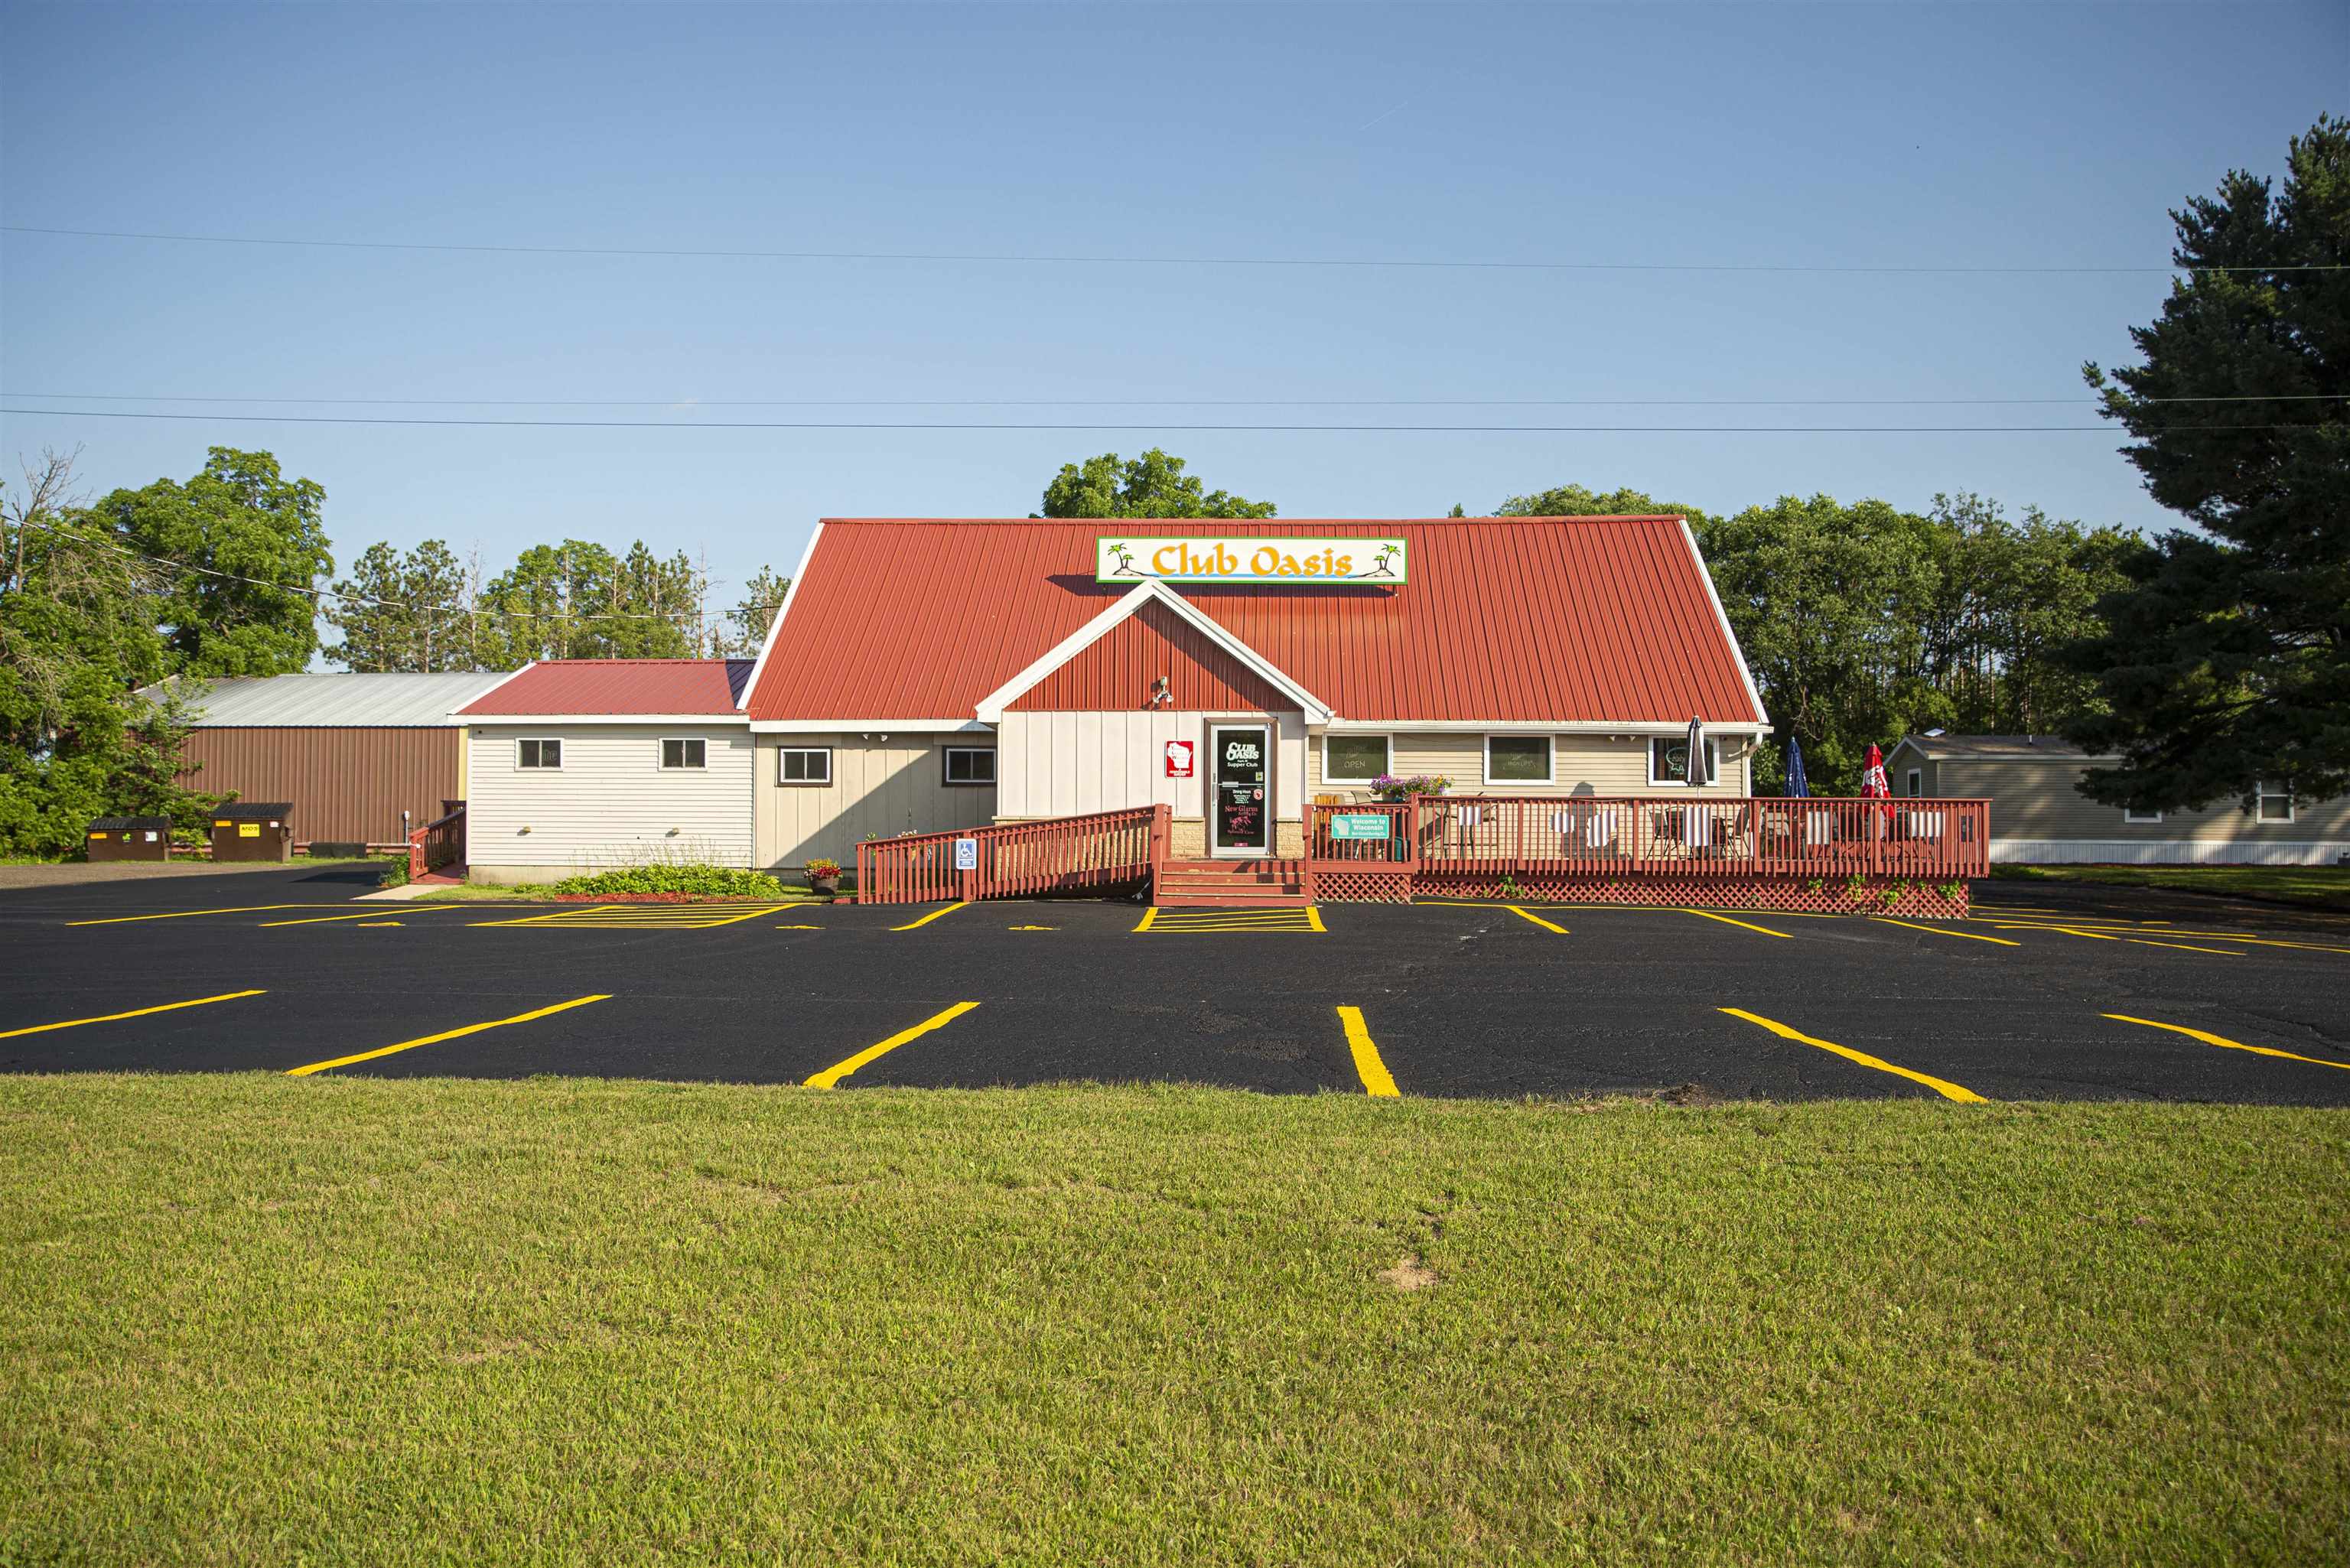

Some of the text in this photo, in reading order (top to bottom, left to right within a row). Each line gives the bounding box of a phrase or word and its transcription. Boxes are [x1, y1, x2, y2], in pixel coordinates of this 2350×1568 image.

[1152, 542, 1352, 577] Club Oasis
[1228, 742, 1255, 751] CLUB
[1226, 750, 1259, 760] OASIS
[1344, 760, 1365, 769] OPEN
